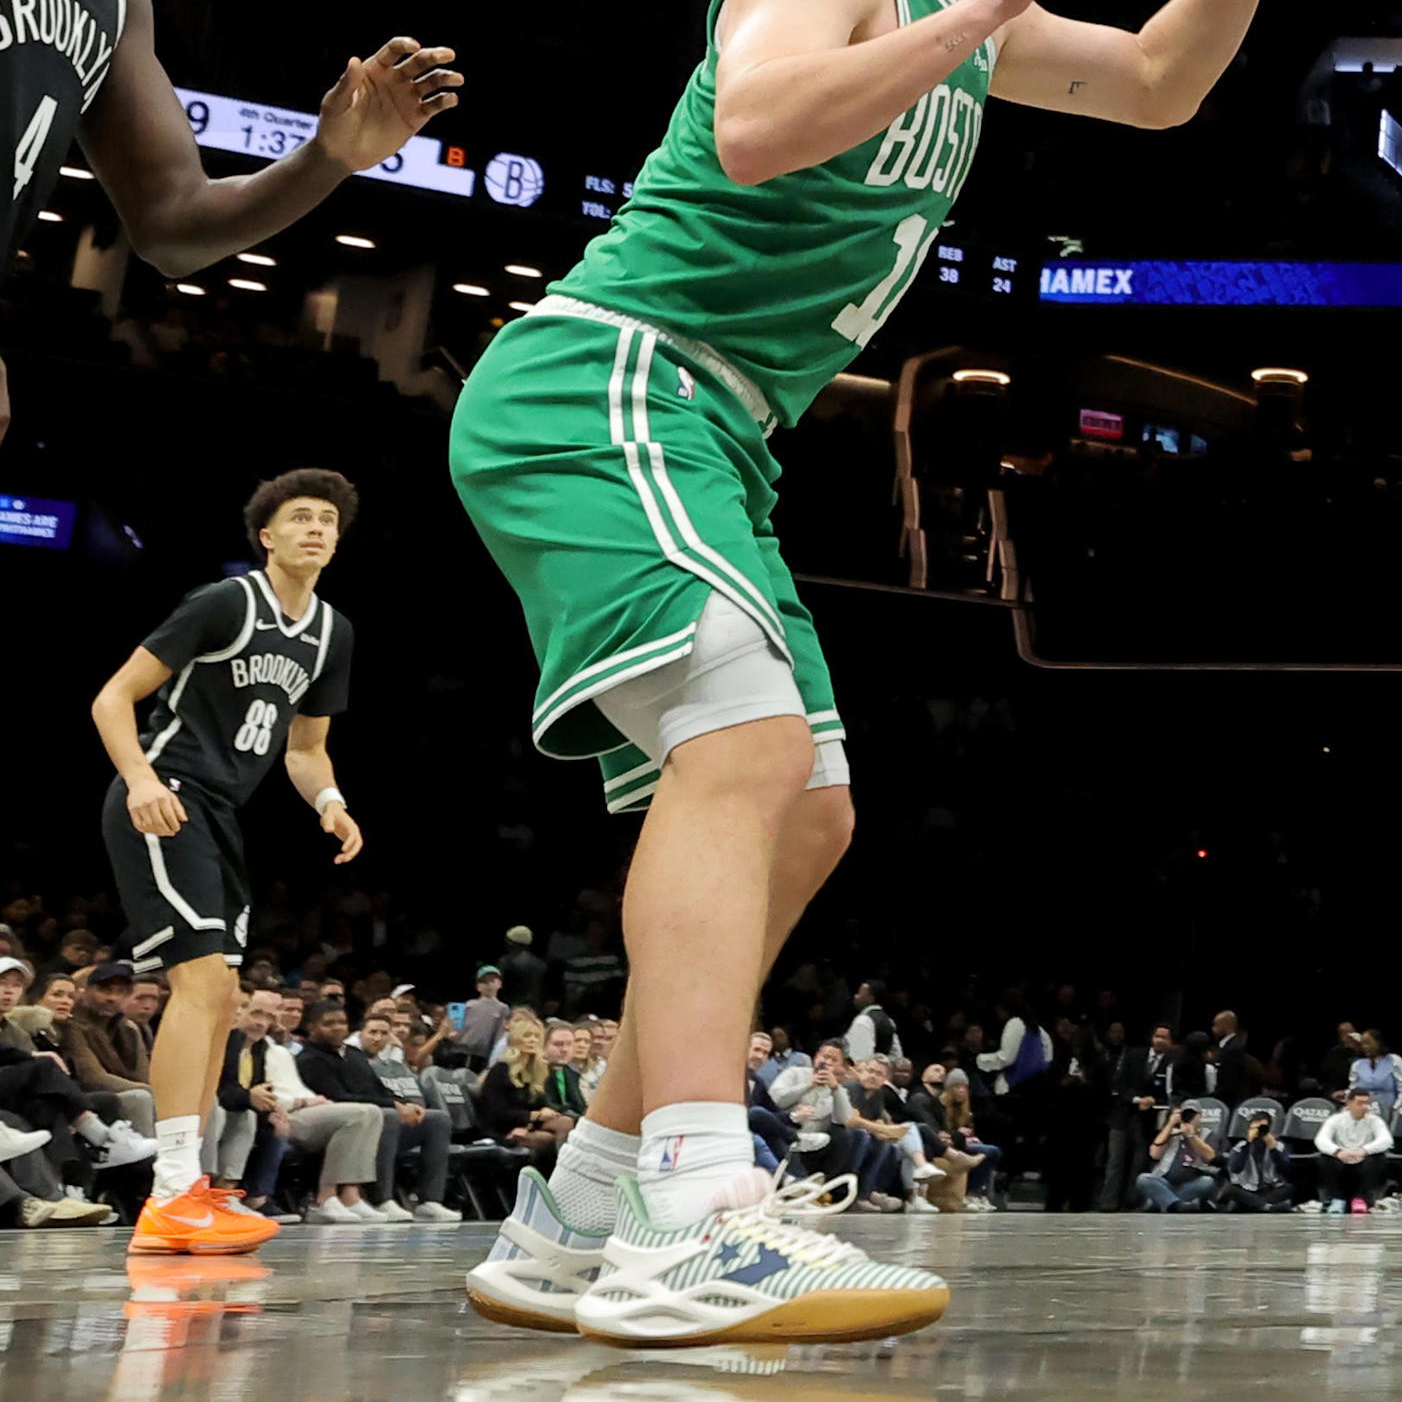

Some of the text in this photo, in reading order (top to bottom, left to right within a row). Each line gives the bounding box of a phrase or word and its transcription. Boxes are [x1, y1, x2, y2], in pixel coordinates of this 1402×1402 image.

[263, 112, 314, 131] Quarter
[863, 83, 984, 205] BOST
[939, 266, 960, 284] 38
[992, 277, 1012, 294] 24
[230, 652, 311, 706] BROOKLYN
[234, 699, 278, 757] 88
